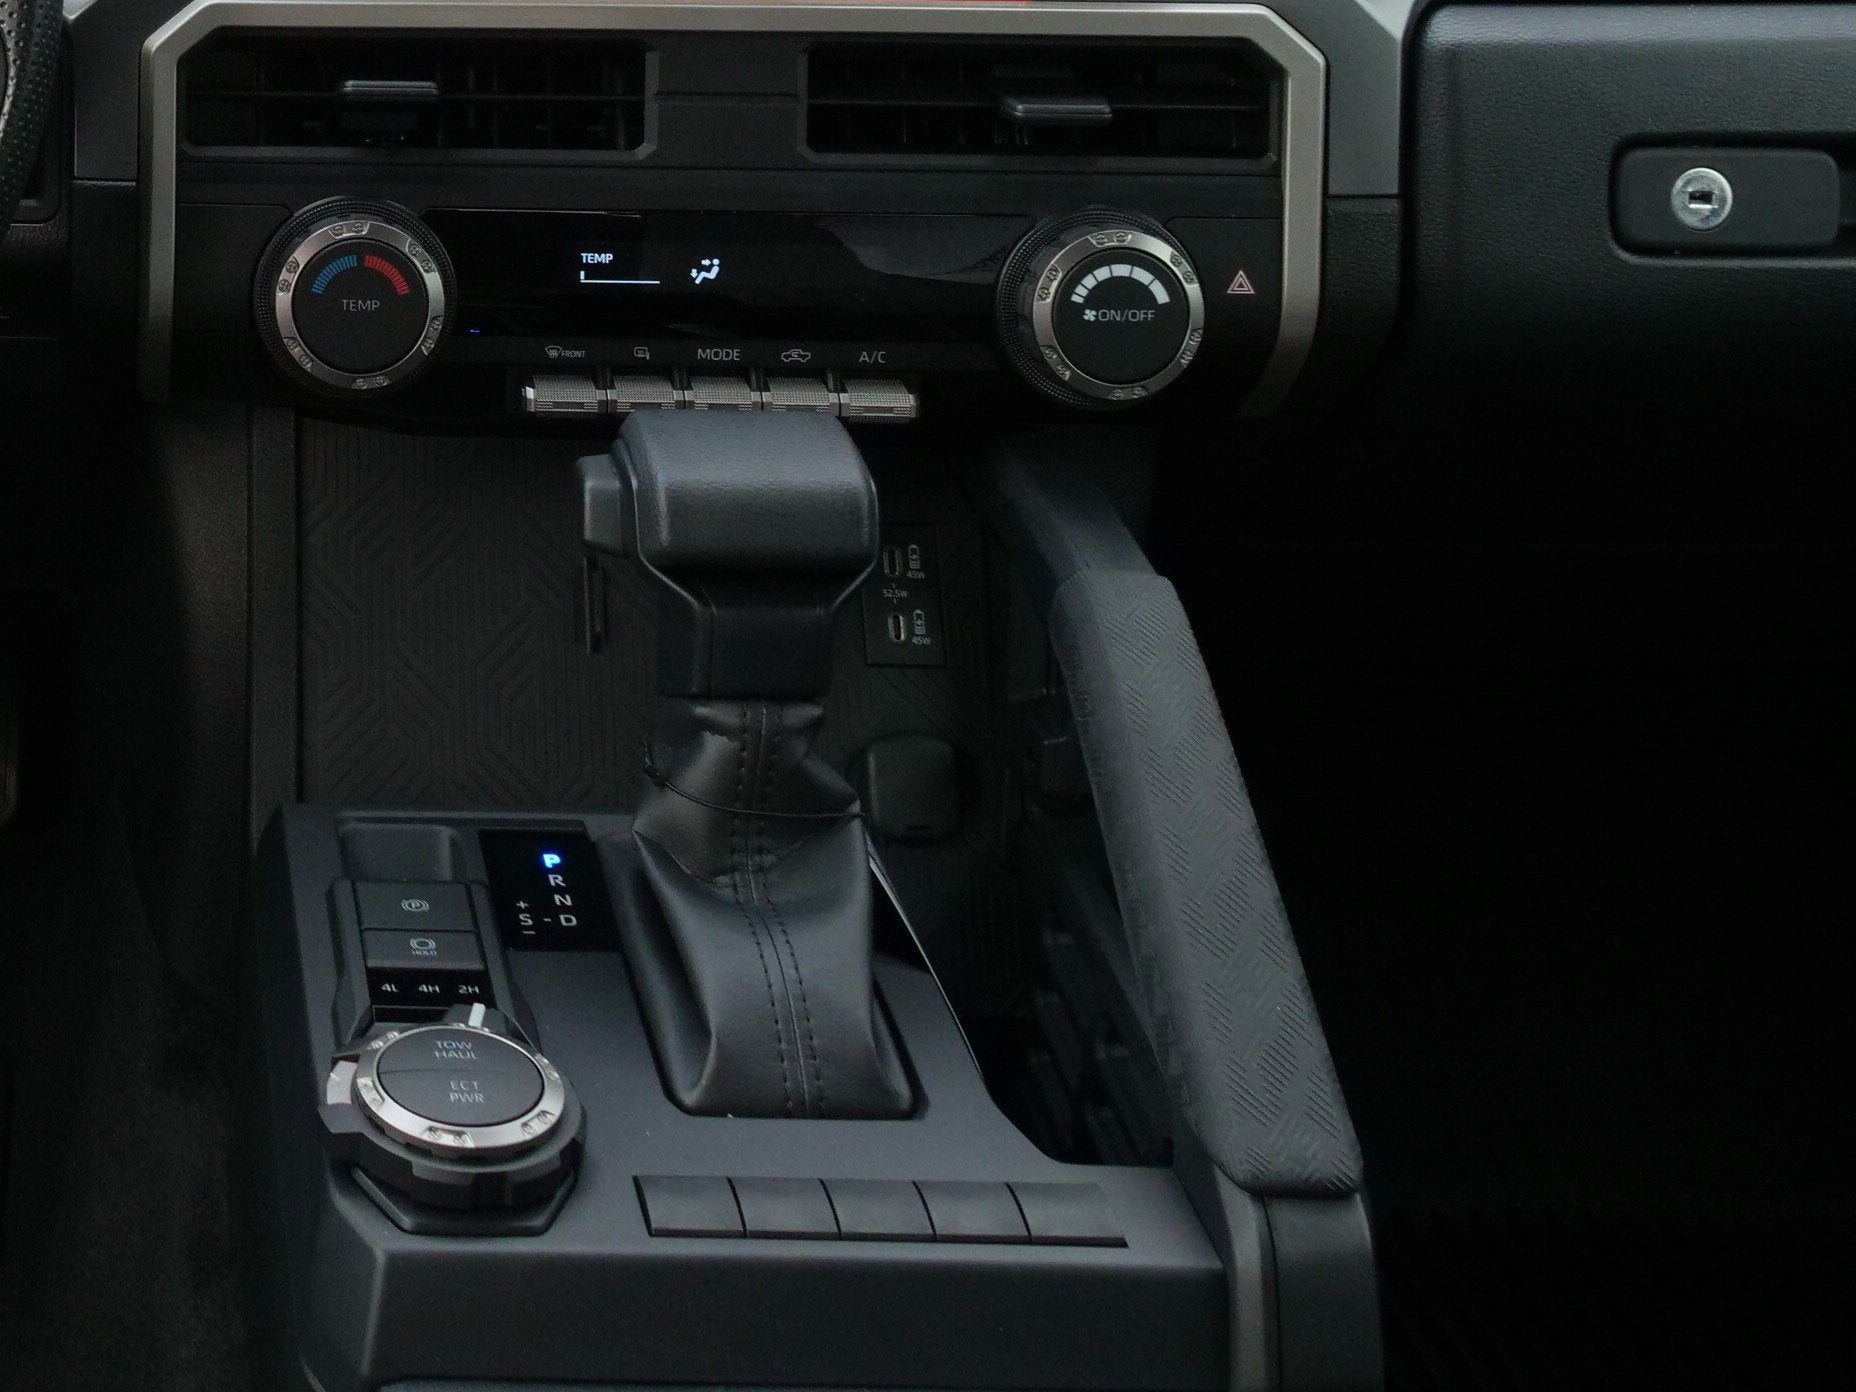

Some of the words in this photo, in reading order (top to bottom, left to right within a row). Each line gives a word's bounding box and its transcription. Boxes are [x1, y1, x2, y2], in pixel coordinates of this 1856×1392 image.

[581, 252, 614, 264] TEMP
[341, 299, 381, 312] TEMP
[1097, 308, 1156, 322] ON/OFF
[561, 350, 586, 358] FRONT
[697, 349, 741, 361] MODE
[858, 350, 887, 364] A/C
[543, 853, 561, 868] P
[548, 874, 566, 887] R
[554, 894, 573, 906] N
[519, 913, 534, 926] S
[559, 914, 578, 927] D
[381, 983, 399, 993] 4L
[418, 984, 441, 994] 4H
[458, 984, 480, 994] 2H
[435, 1040, 472, 1050] TOW
[435, 1050, 479, 1060] HAUL
[449, 1080, 479, 1091] ECT
[450, 1092, 485, 1103] PWR
